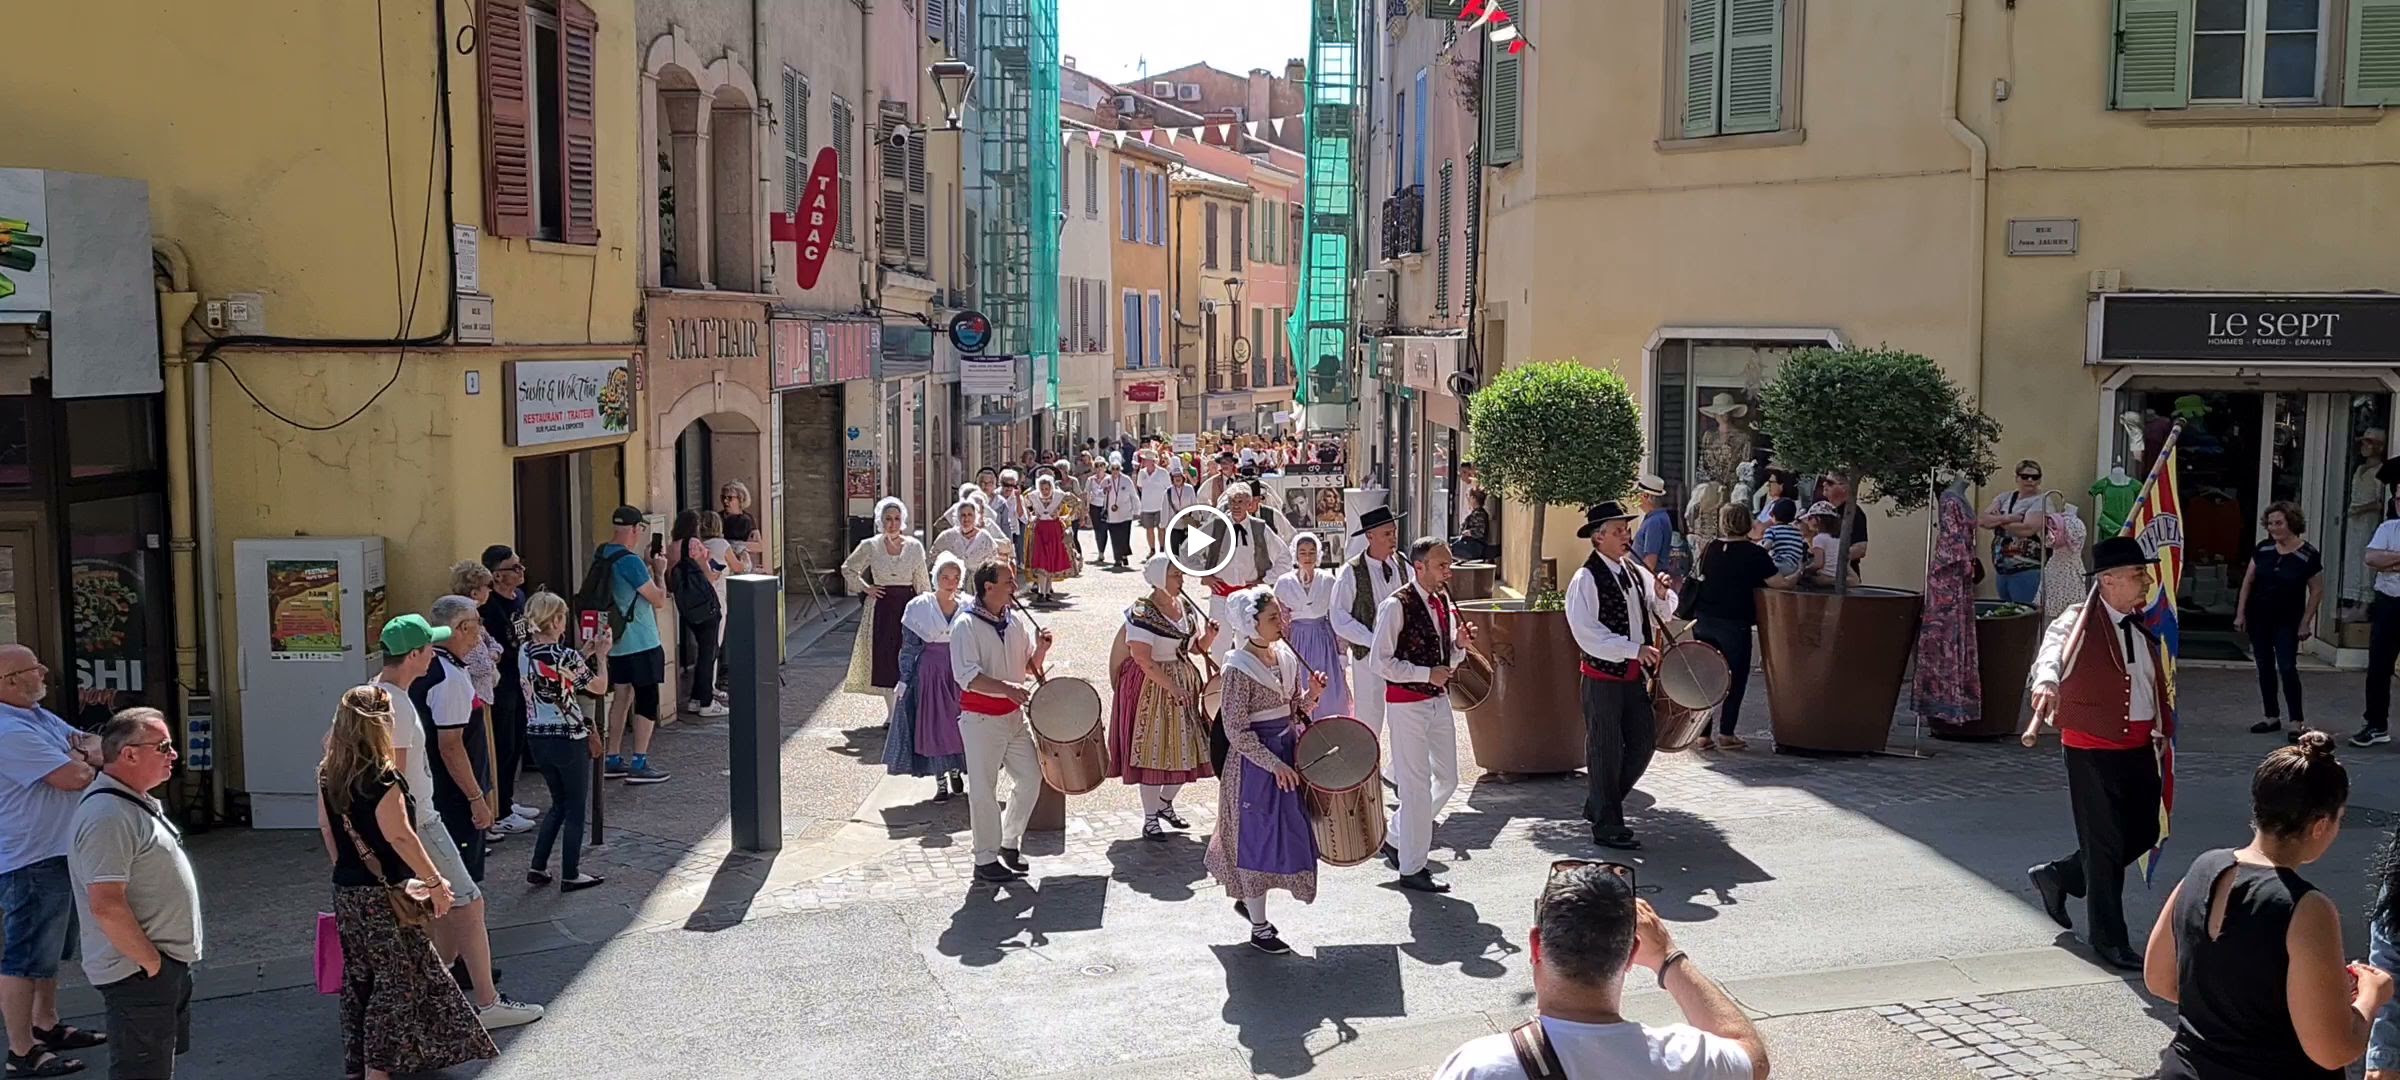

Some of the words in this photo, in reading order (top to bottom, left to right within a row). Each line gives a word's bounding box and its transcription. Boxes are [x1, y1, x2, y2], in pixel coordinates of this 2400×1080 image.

[804, 176, 830, 261] TABAC
[666, 317, 759, 360] MAT'HAIR
[2207, 337, 2245, 346] HOMMES
[2252, 337, 2287, 346] FEMMES
[2294, 337, 2332, 347] ENFANTS
[518, 378, 546, 402] Sushi
[546, 379, 556, 407] &
[557, 373, 579, 401] Wok
[523, 410, 563, 425] RESTAURANT
[567, 407, 595, 420] TRAITEUR
[544, 424, 557, 432] PLACE
